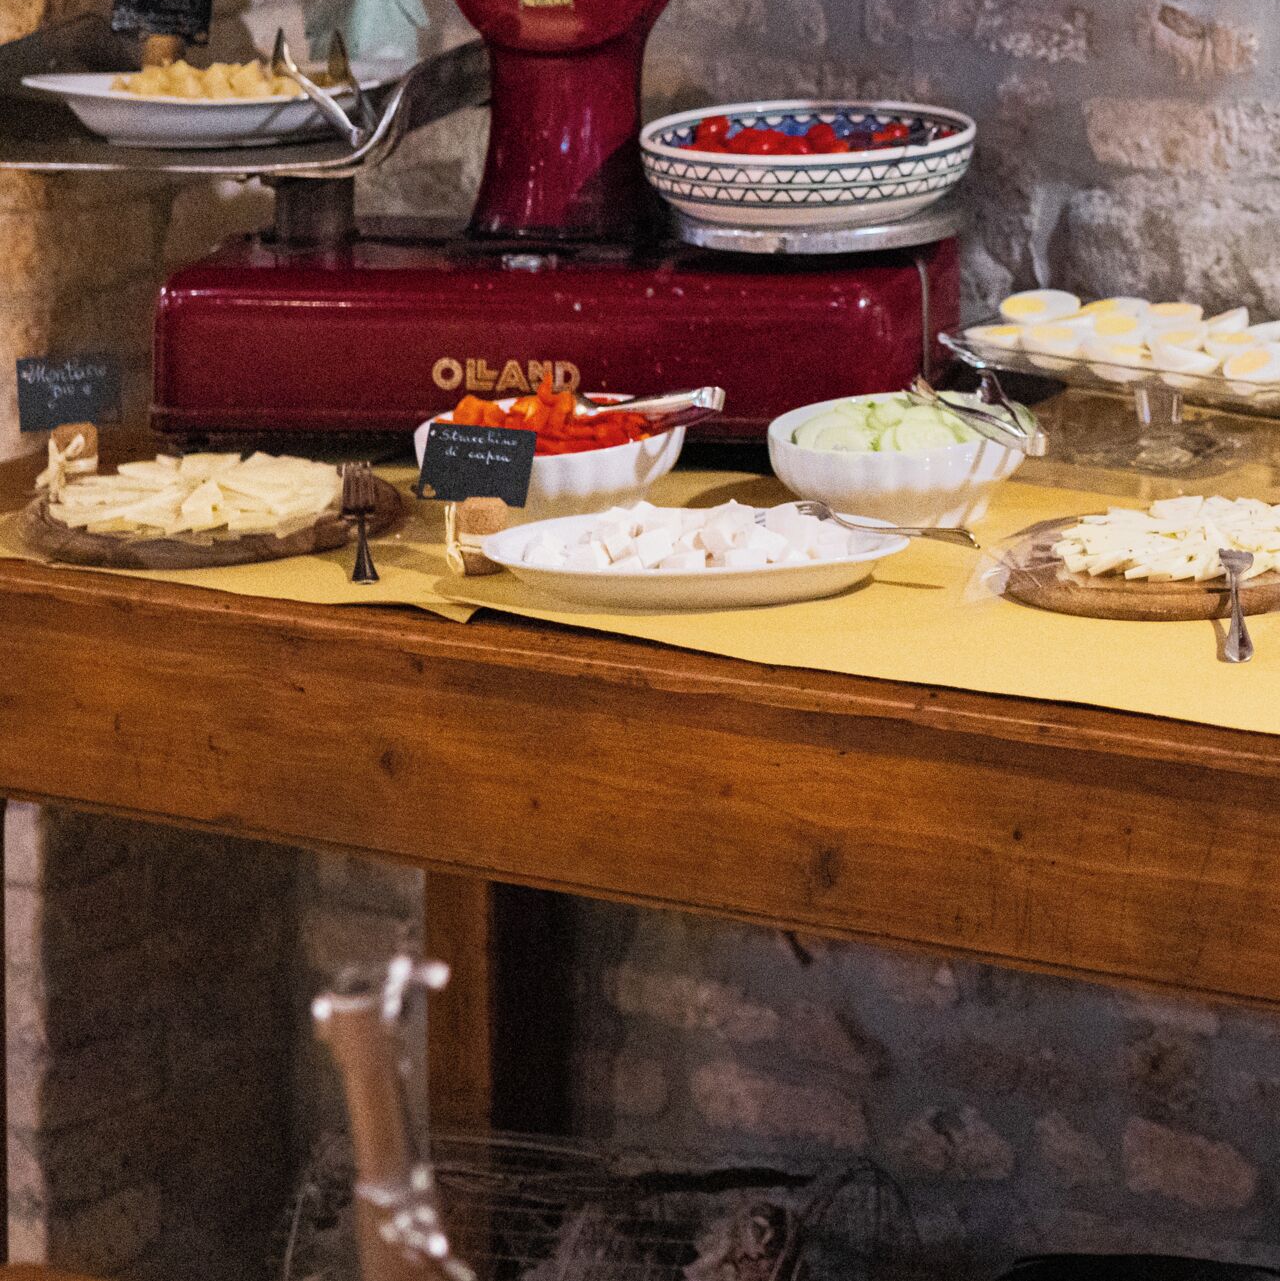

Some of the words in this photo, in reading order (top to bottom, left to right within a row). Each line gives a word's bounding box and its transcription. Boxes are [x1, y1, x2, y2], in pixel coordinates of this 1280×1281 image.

[432, 356, 582, 393] OLLAND
[438, 429, 519, 447] Stracchino
[444, 446, 458, 458] di
[467, 450, 512, 466] capra
